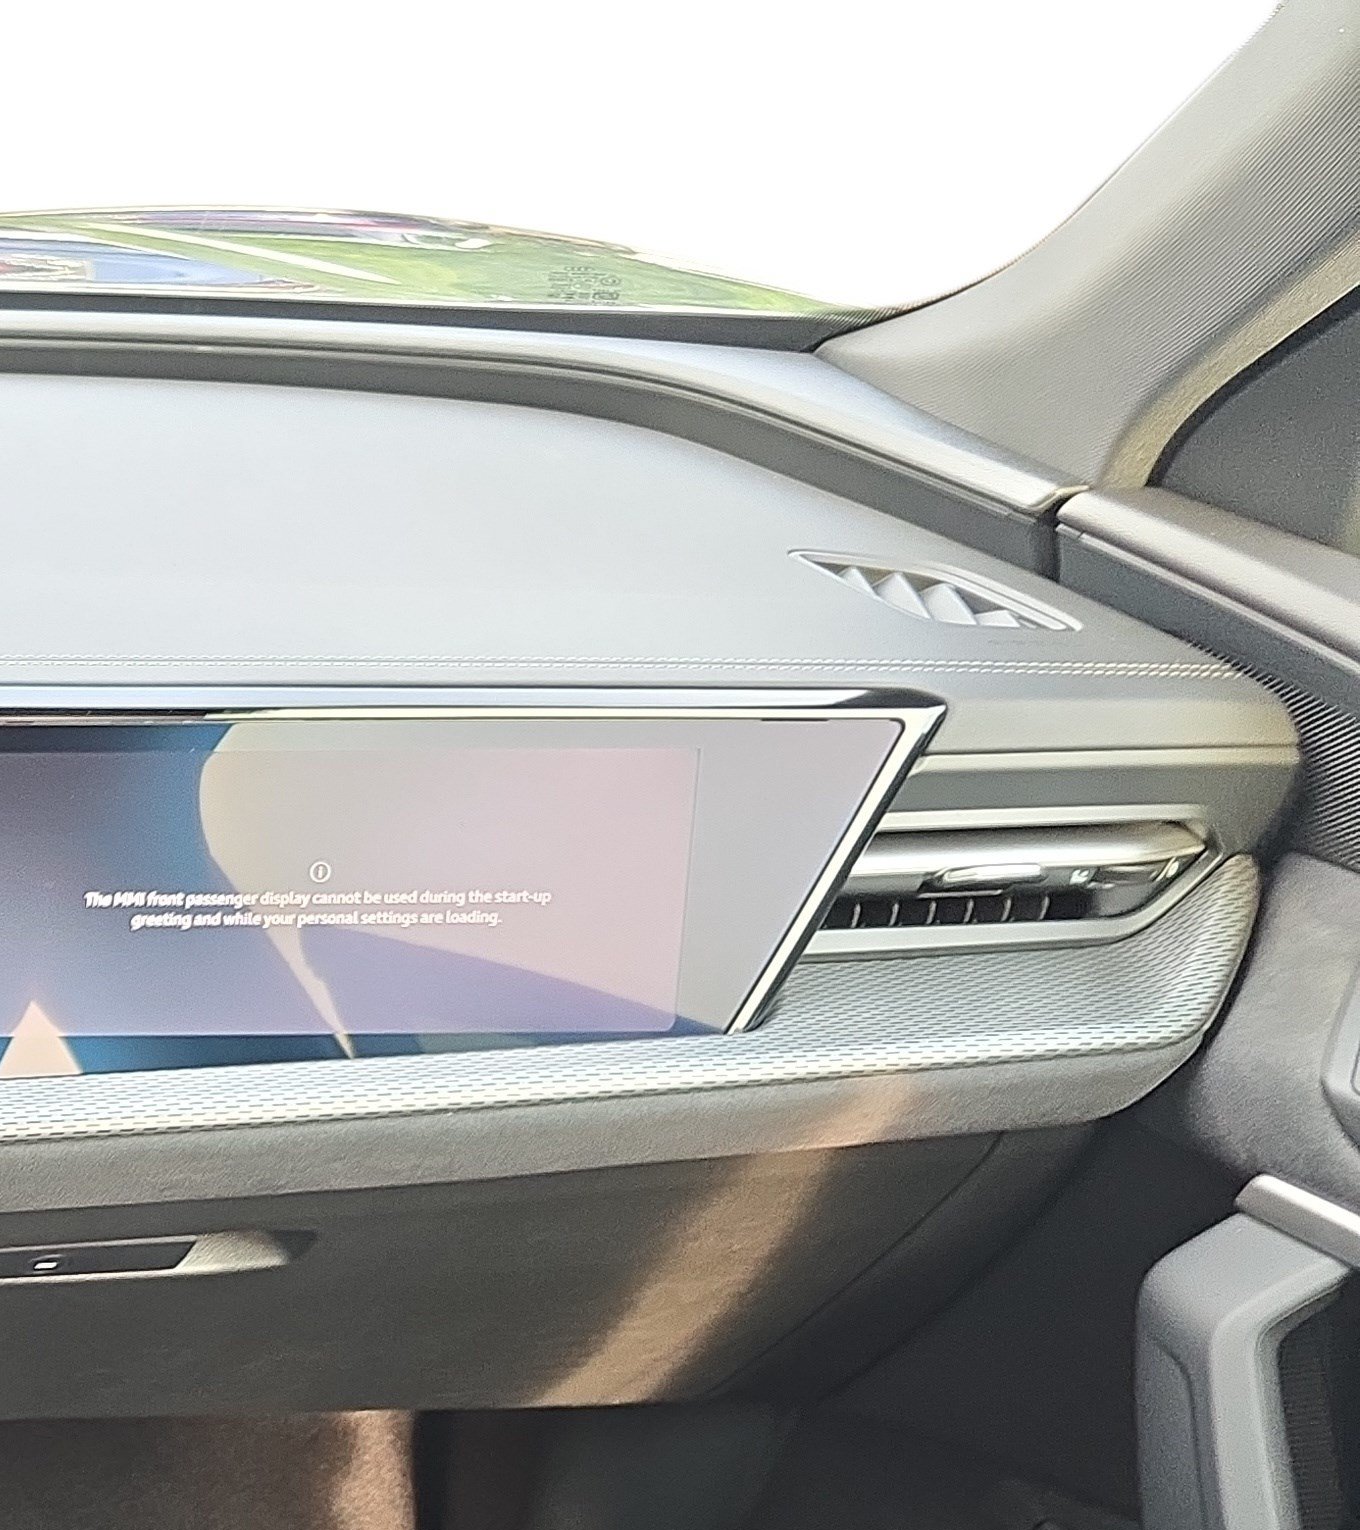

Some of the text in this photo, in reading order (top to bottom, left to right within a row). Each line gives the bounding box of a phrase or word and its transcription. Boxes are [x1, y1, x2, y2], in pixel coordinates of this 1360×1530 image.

[84, 891, 112, 908] The
[146, 890, 185, 907] front
[185, 891, 259, 910] passenger
[259, 889, 310, 909] display
[311, 890, 361, 906] cannot
[362, 889, 382, 904] be
[382, 889, 418, 904] used
[418, 888, 466, 908] during
[467, 888, 493, 903] the
[494, 888, 552, 907] start-up
[130, 908, 503, 931] greeting and while your personal settings are loading.
